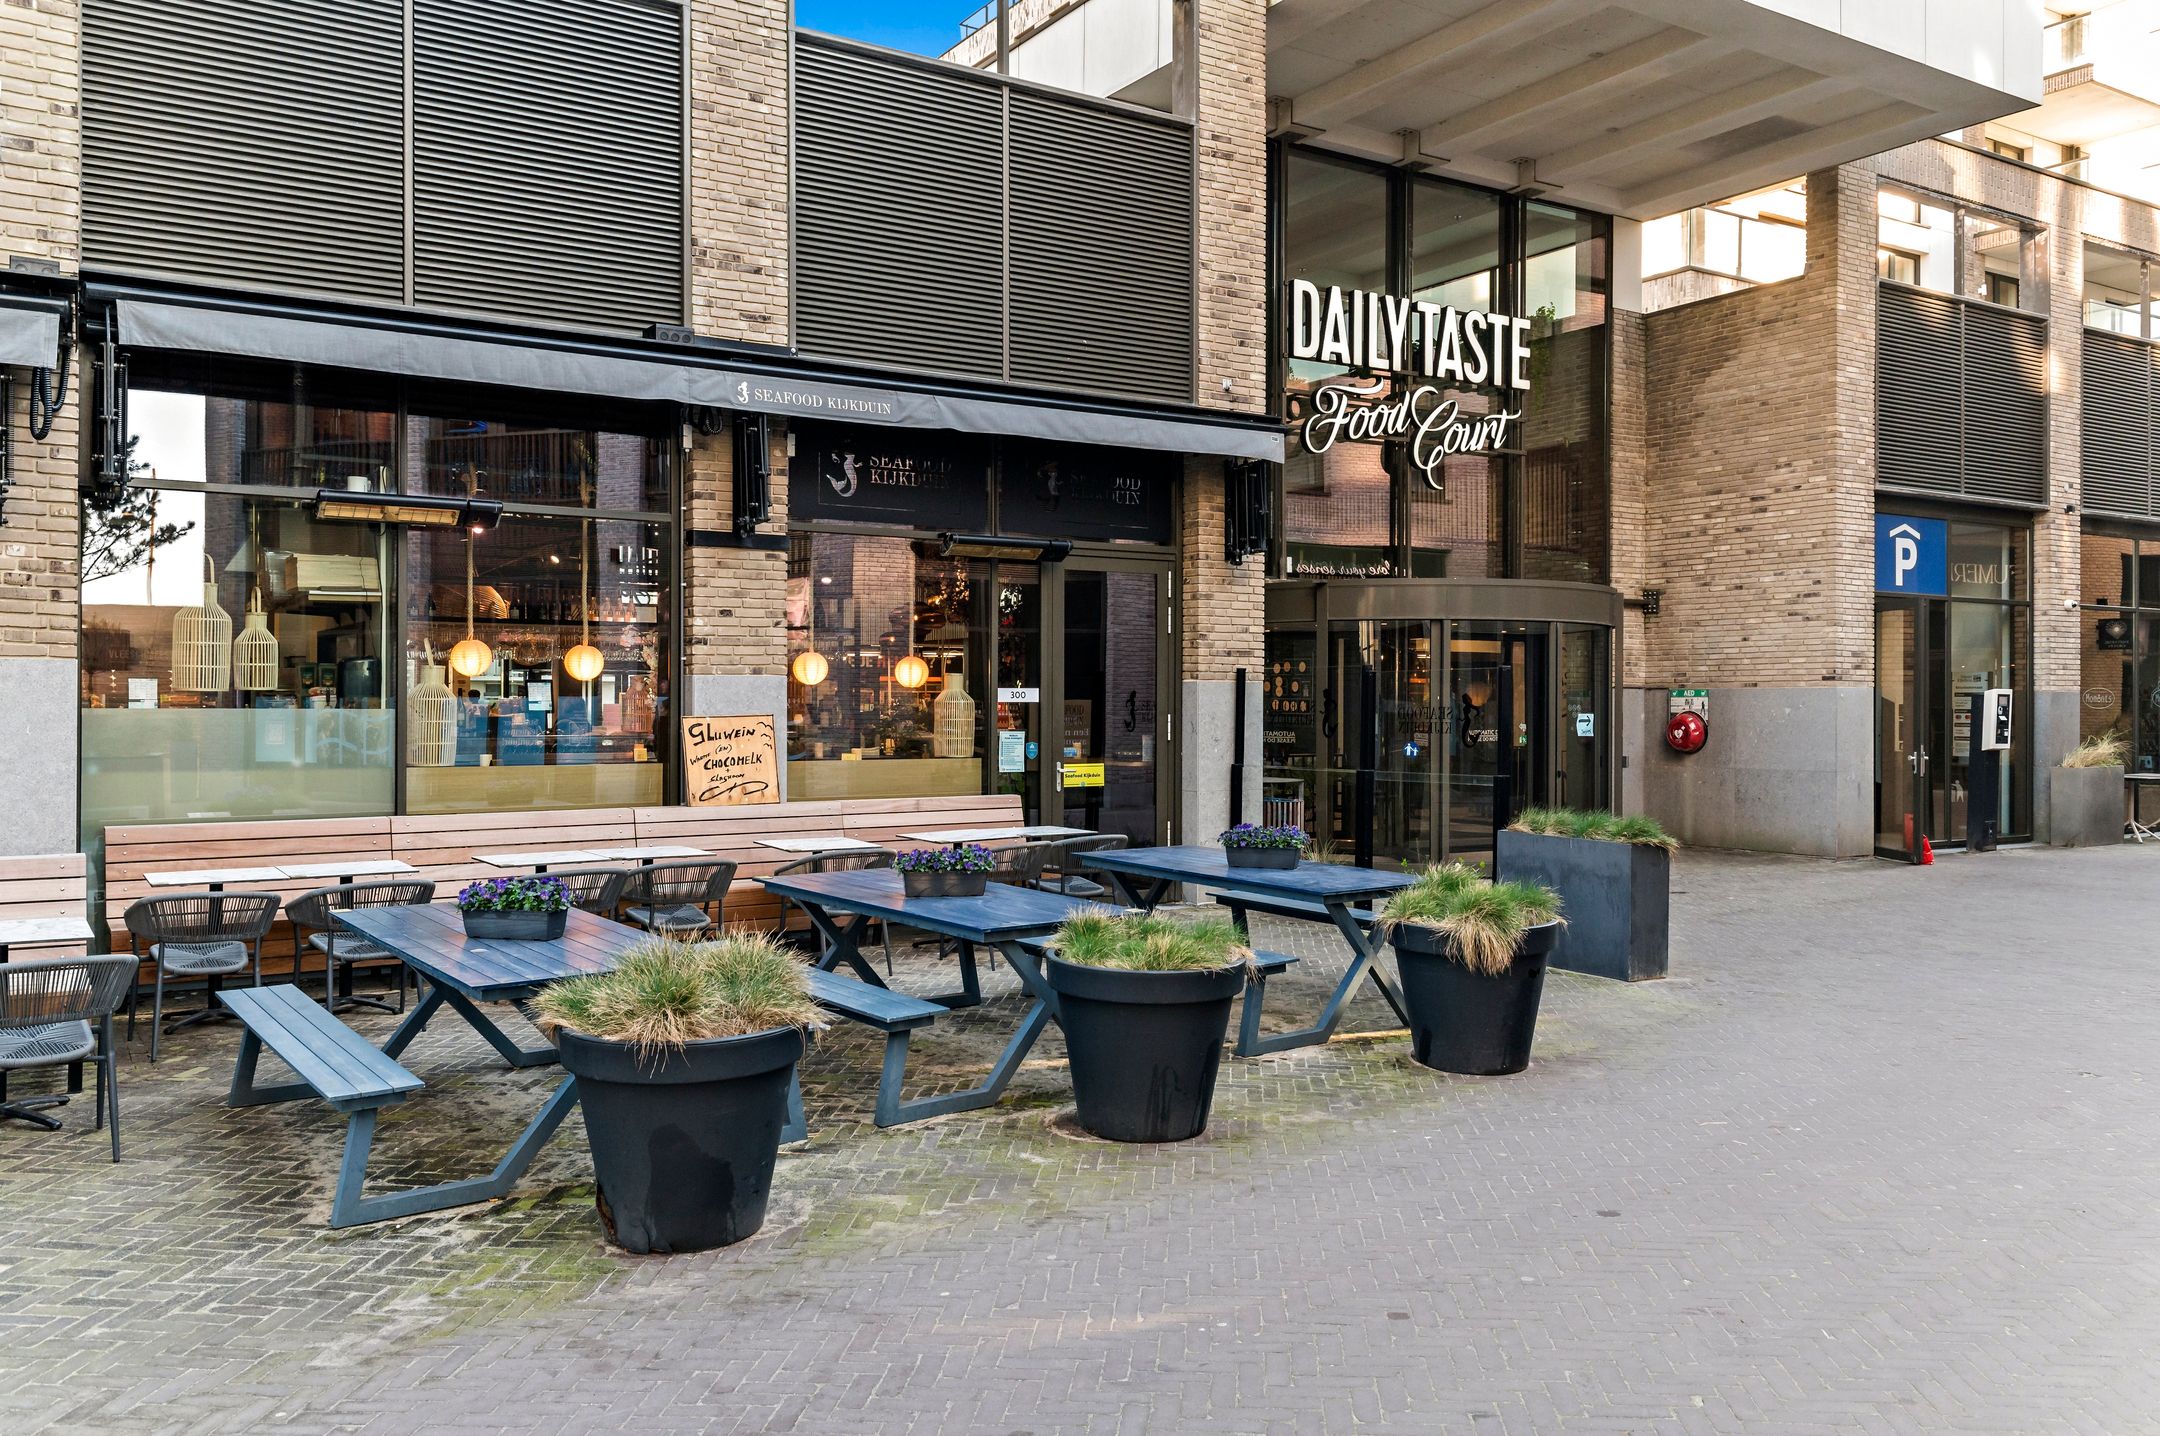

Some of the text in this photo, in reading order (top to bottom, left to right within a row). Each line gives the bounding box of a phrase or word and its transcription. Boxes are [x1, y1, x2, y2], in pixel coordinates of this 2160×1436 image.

[1291, 278, 1531, 390] DAILY TASTE
[754, 388, 892, 415] SEAFOOD KIJKDUIN
[1304, 377, 1522, 490] Food Court
[1895, 537, 1918, 586] P
[1010, 691, 1026, 699] 300
